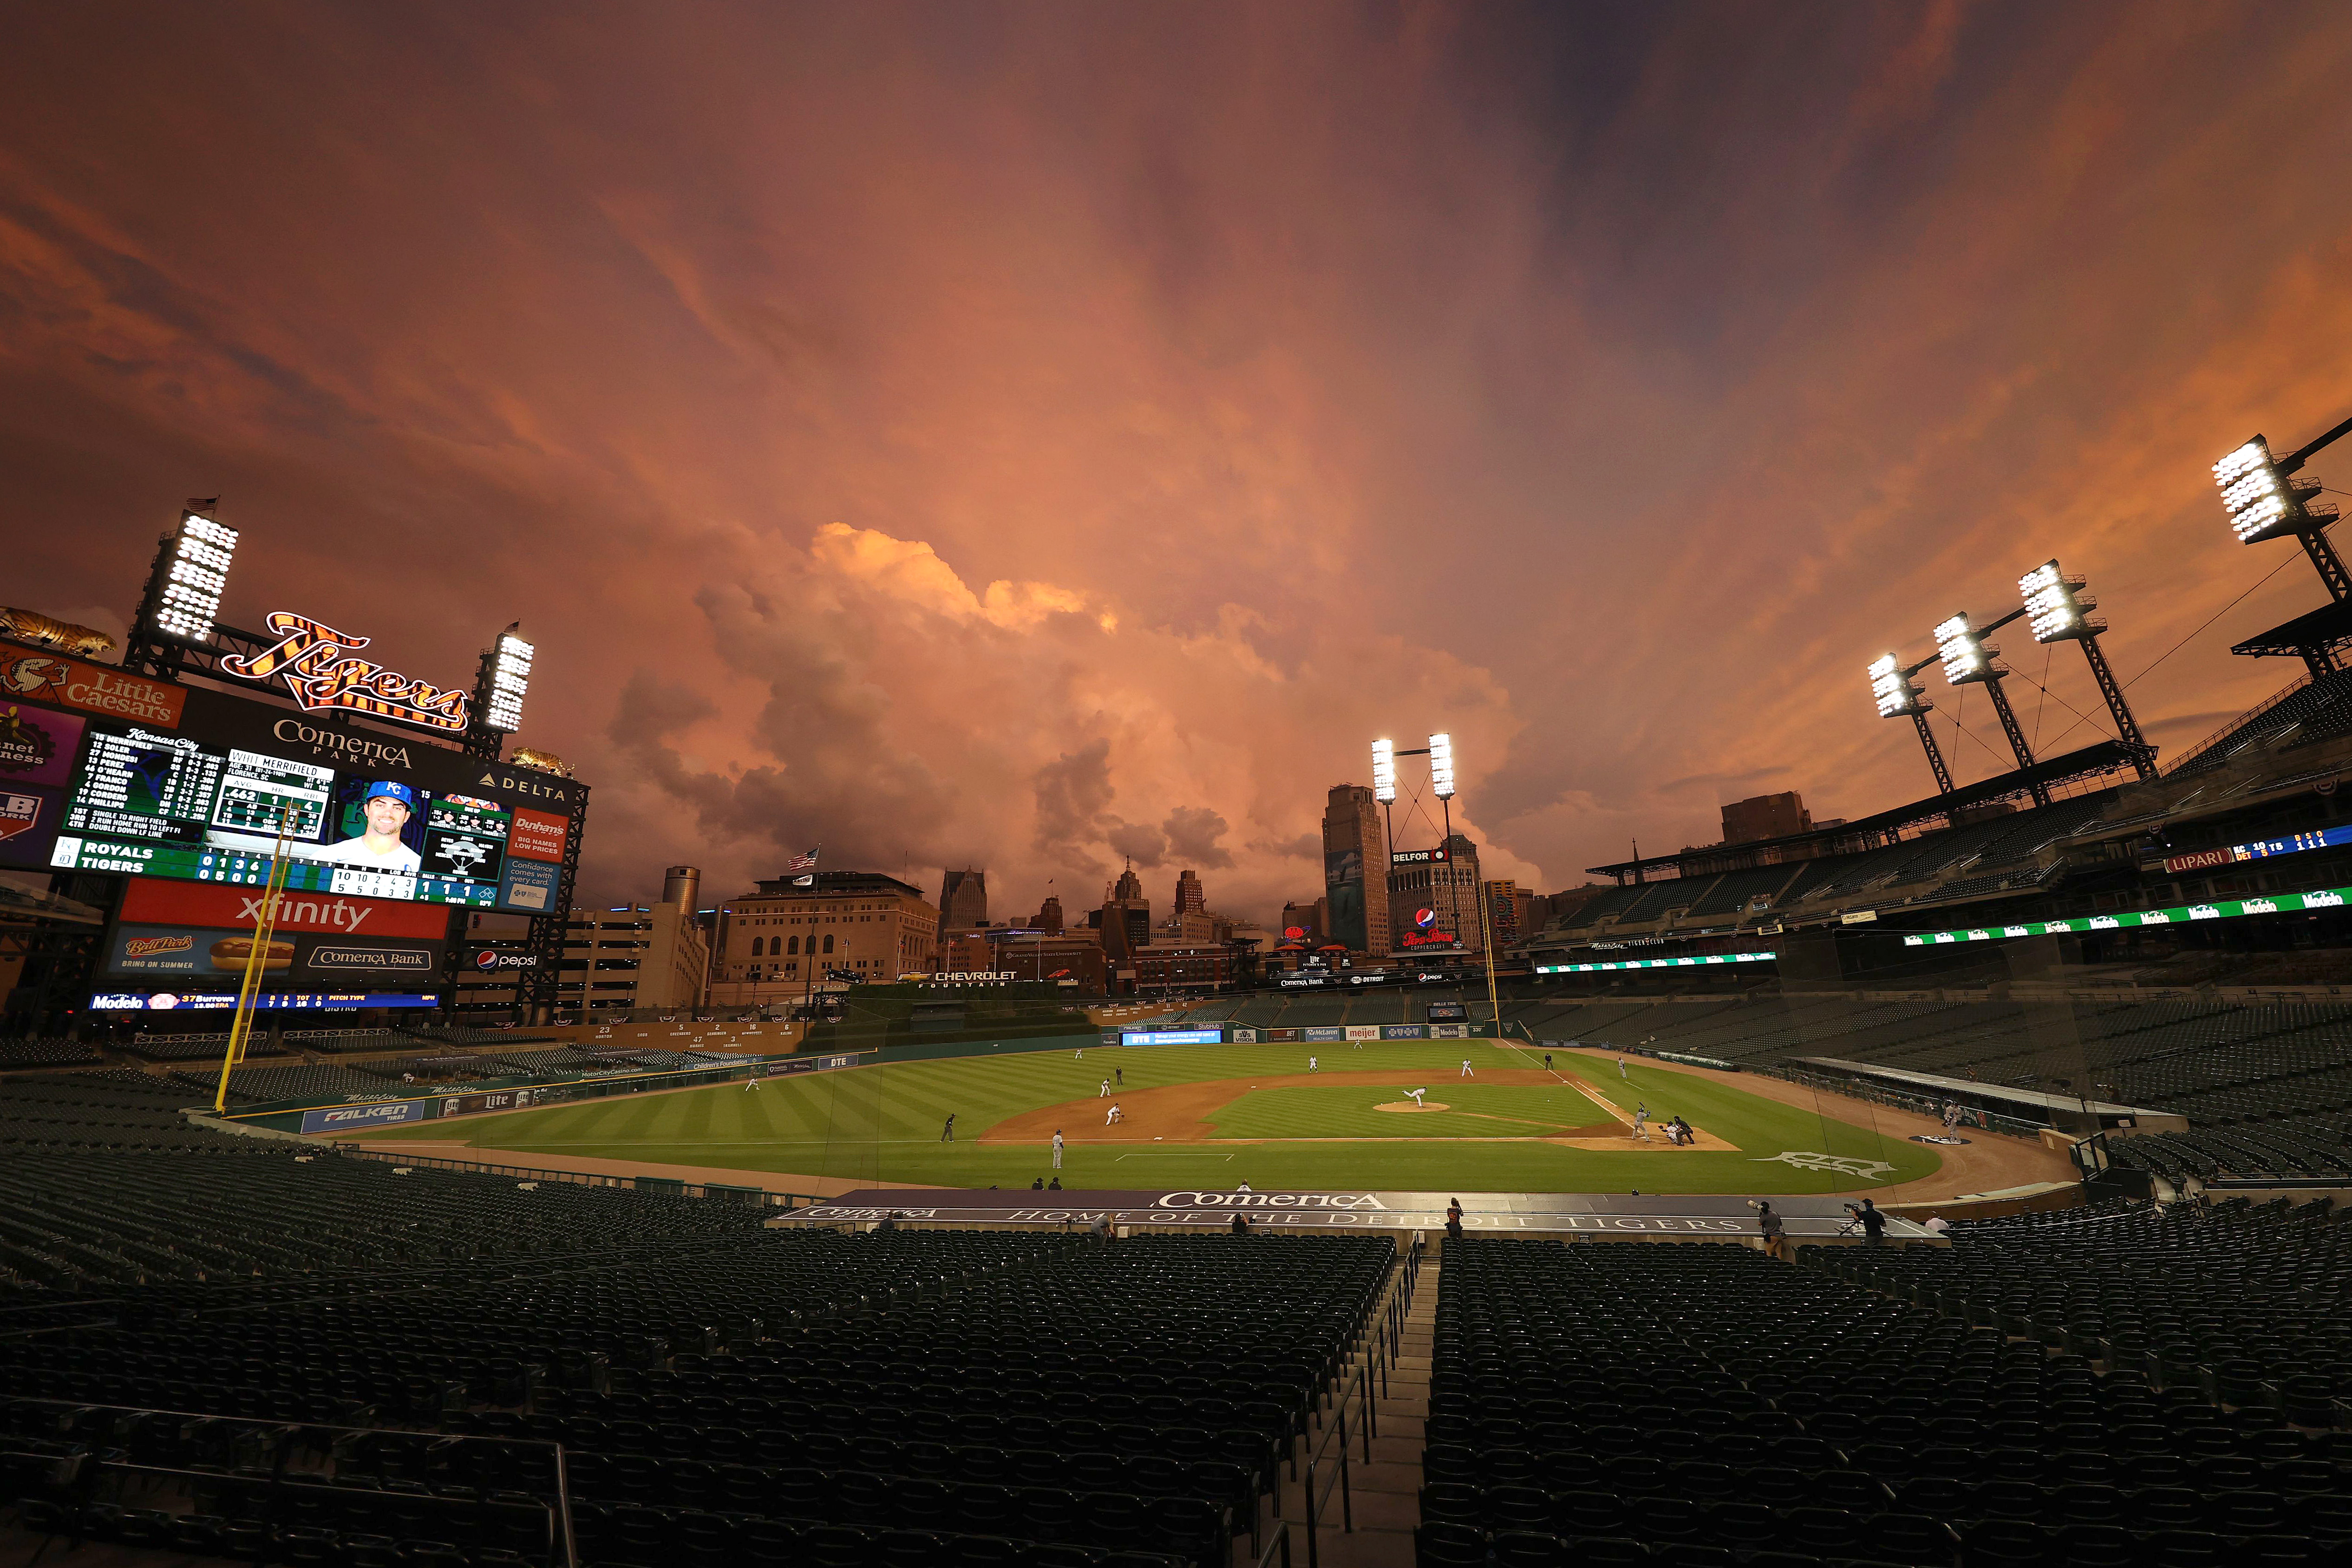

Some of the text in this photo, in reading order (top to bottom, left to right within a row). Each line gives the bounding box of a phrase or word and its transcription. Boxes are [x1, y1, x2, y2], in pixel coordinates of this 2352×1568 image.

[221, 611, 468, 732] Tigers
[93, 672, 165, 705] Little
[66, 683, 171, 722] Caesars
[107, 735, 152, 751] MERRIFIELD
[126, 728, 199, 751] Kansas City
[105, 744, 130, 754] SOLER
[102, 751, 138, 763] MONDESI
[312, 746, 377, 767] PARK
[100, 759, 124, 769] PEREZ
[233, 751, 317, 776] WHIT MERRIFIELD
[98, 767, 133, 778] O'HEARN
[95, 775, 128, 785] FRANCO
[93, 783, 126, 793] GORDON
[503, 777, 565, 802] DELTA
[90, 790, 128, 802] CORDERO
[225, 789, 256, 801] .462
[88, 798, 124, 809] PHILLIPS
[304, 802, 312, 810] 4
[516, 818, 564, 835] Dunham's
[532, 839, 557, 848] NAMES
[532, 845, 558, 854] PRICES
[2233, 842, 2284, 854] KC 10 T5
[2297, 837, 2328, 851] 1 1 1
[85, 842, 259, 871] ROYALS 0 1 3 6
[1393, 852, 1429, 862] BELFOR
[2173, 851, 2224, 871] LIPARI
[2235, 849, 2269, 861] DET 5
[81, 857, 256, 883] TIGERS 0 5 0 0
[512, 861, 553, 872] Confidence
[510, 876, 530, 884] every
[2301, 893, 2344, 908] Modelo
[235, 893, 372, 932] xfinity
[2188, 907, 2220, 920] Modelo
[2241, 901, 2277, 915] Modelo
[2089, 918, 2119, 929] Modelo
[2140, 913, 2170, 925] Modelo
[126, 935, 192, 955] Ball Park
[390, 954, 424, 964] Bank
[498, 955, 537, 967] pepsi
[935, 971, 1017, 981] CHEVROLET
[92, 995, 143, 1009] Modelo
[1350, 1029, 1376, 1039] meijer
[831, 1058, 846, 1067] DTE
[581, 1067, 642, 1077] MotorCityCasino.com
[485, 1095, 509, 1109] Lite
[325, 1104, 408, 1121] FALKEN
[1006, 1210, 1743, 1232] HOME OF THE DETROIT TIGERS
